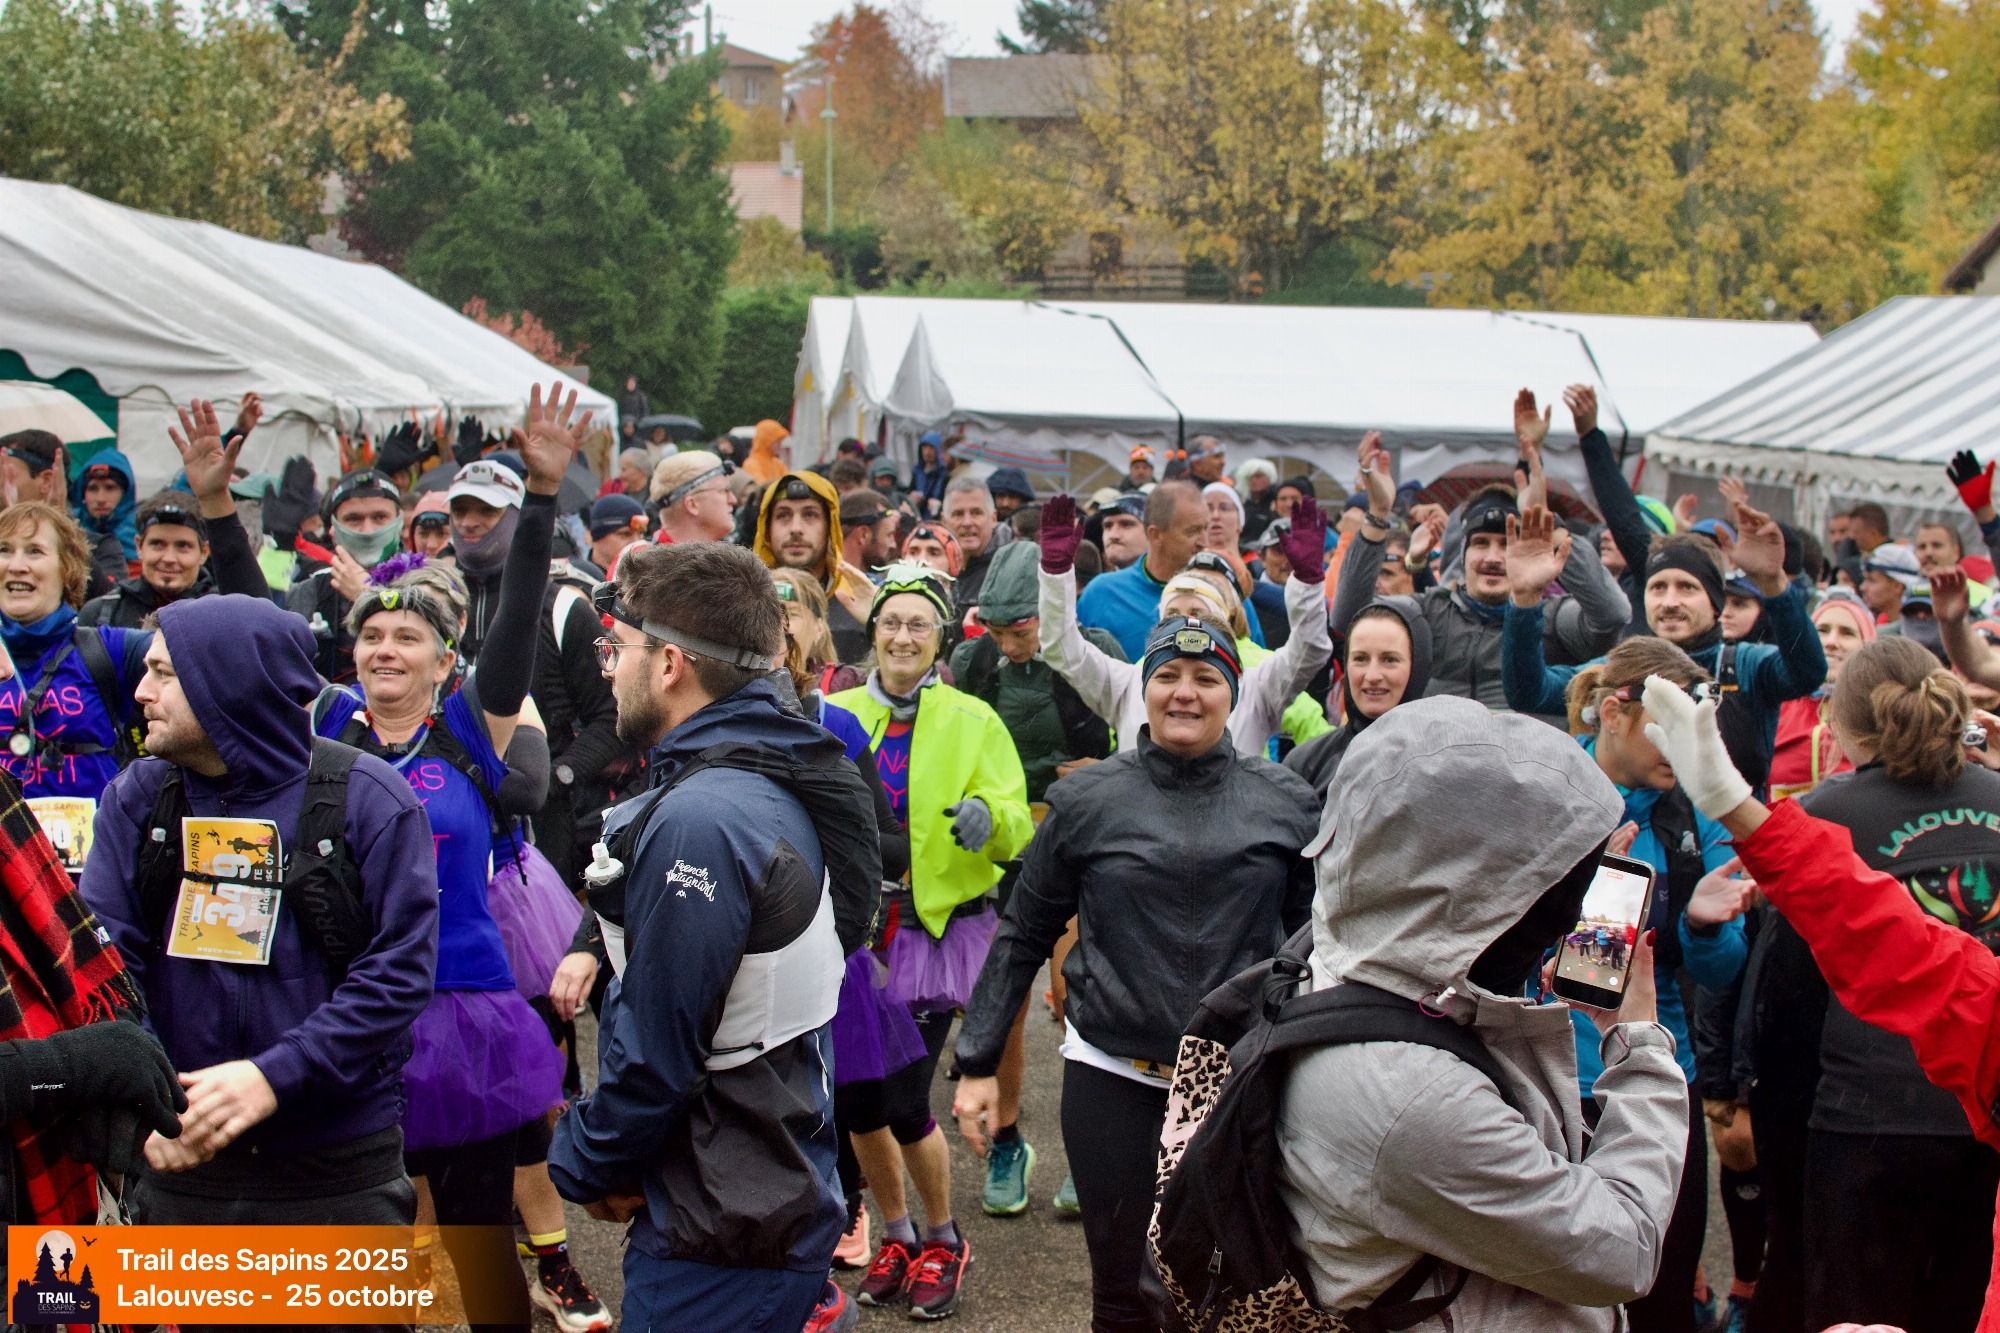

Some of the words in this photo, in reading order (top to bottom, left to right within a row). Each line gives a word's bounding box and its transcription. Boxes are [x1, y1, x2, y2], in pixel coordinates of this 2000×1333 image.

[264, 851, 275, 866] 07
[672, 859, 709, 881] French
[203, 853, 252, 928] 349
[178, 905, 193, 938] TRAIL
